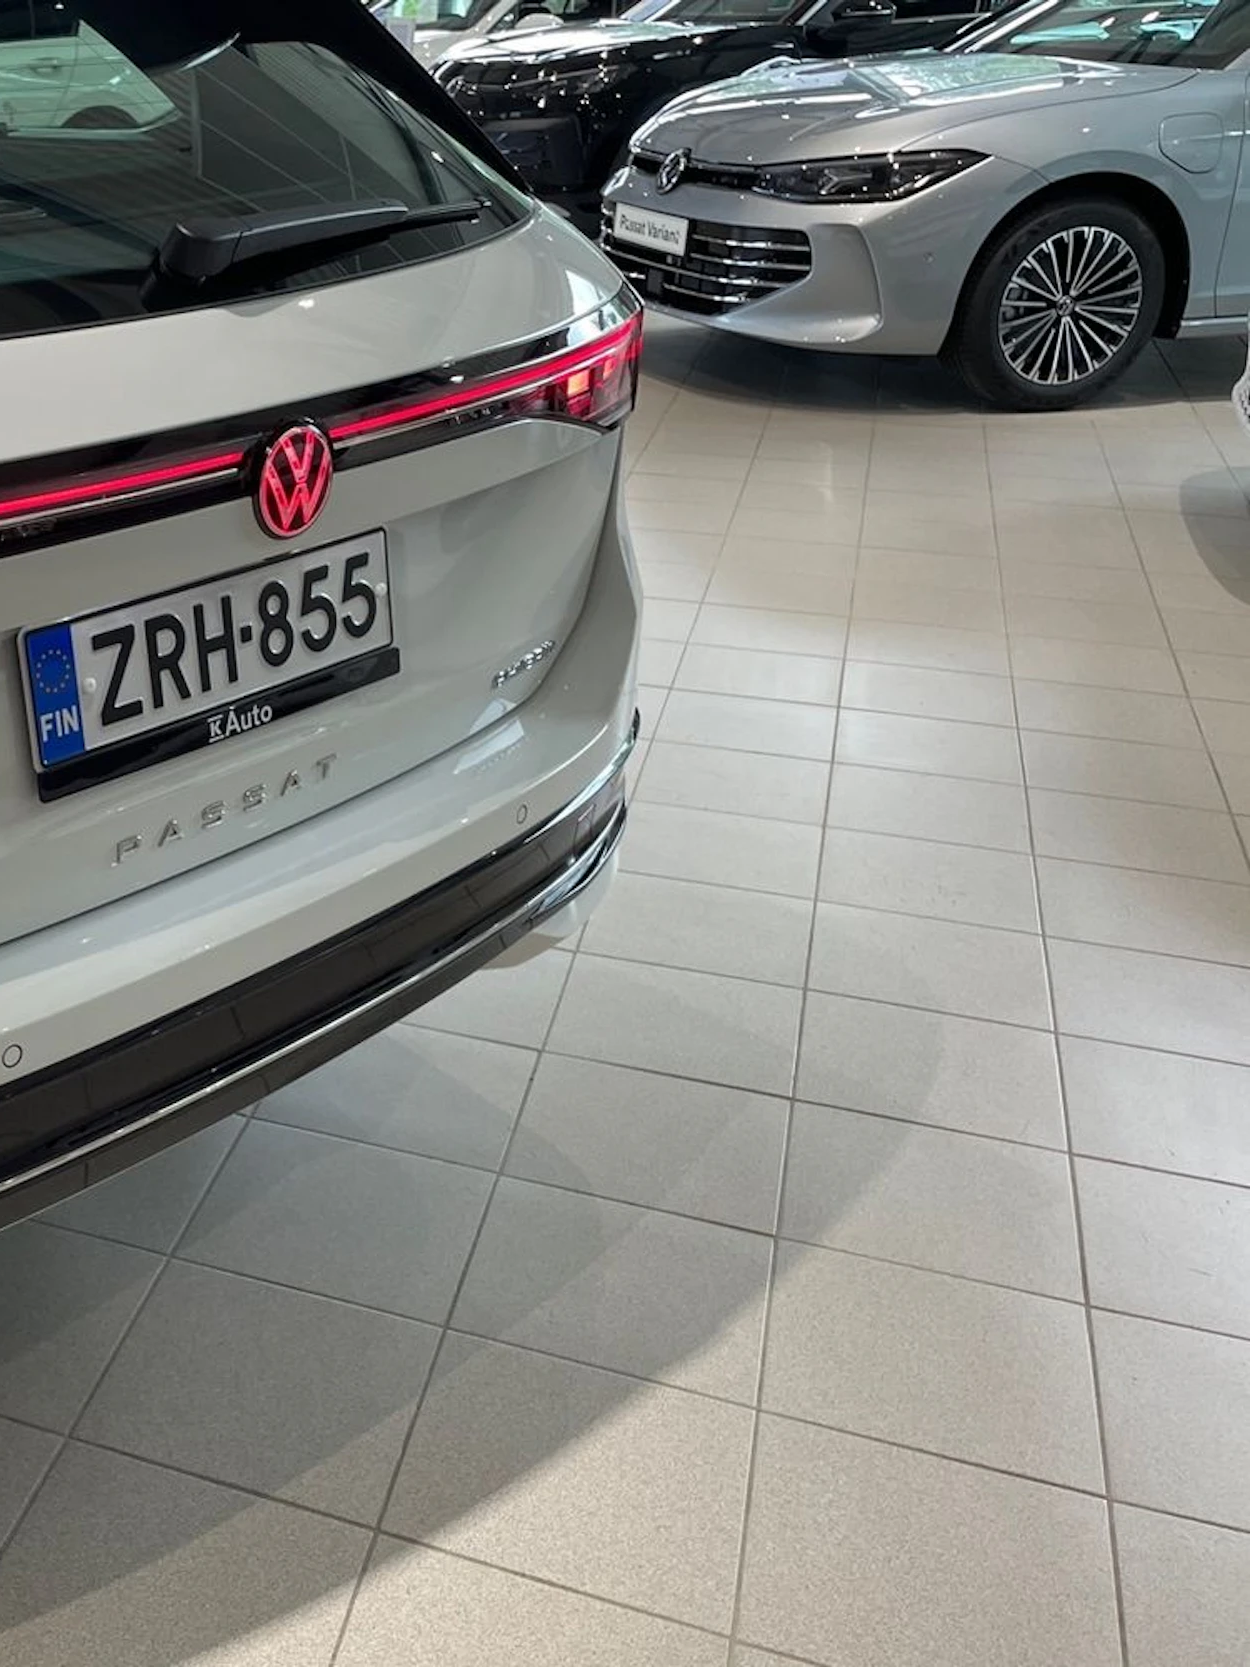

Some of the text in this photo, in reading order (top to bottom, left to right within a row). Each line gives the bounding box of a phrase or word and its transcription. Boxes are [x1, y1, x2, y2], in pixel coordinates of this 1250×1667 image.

[91, 552, 377, 727] ZRH-855
[40, 704, 80, 743] FIN
[111, 753, 337, 868] PASSAT
